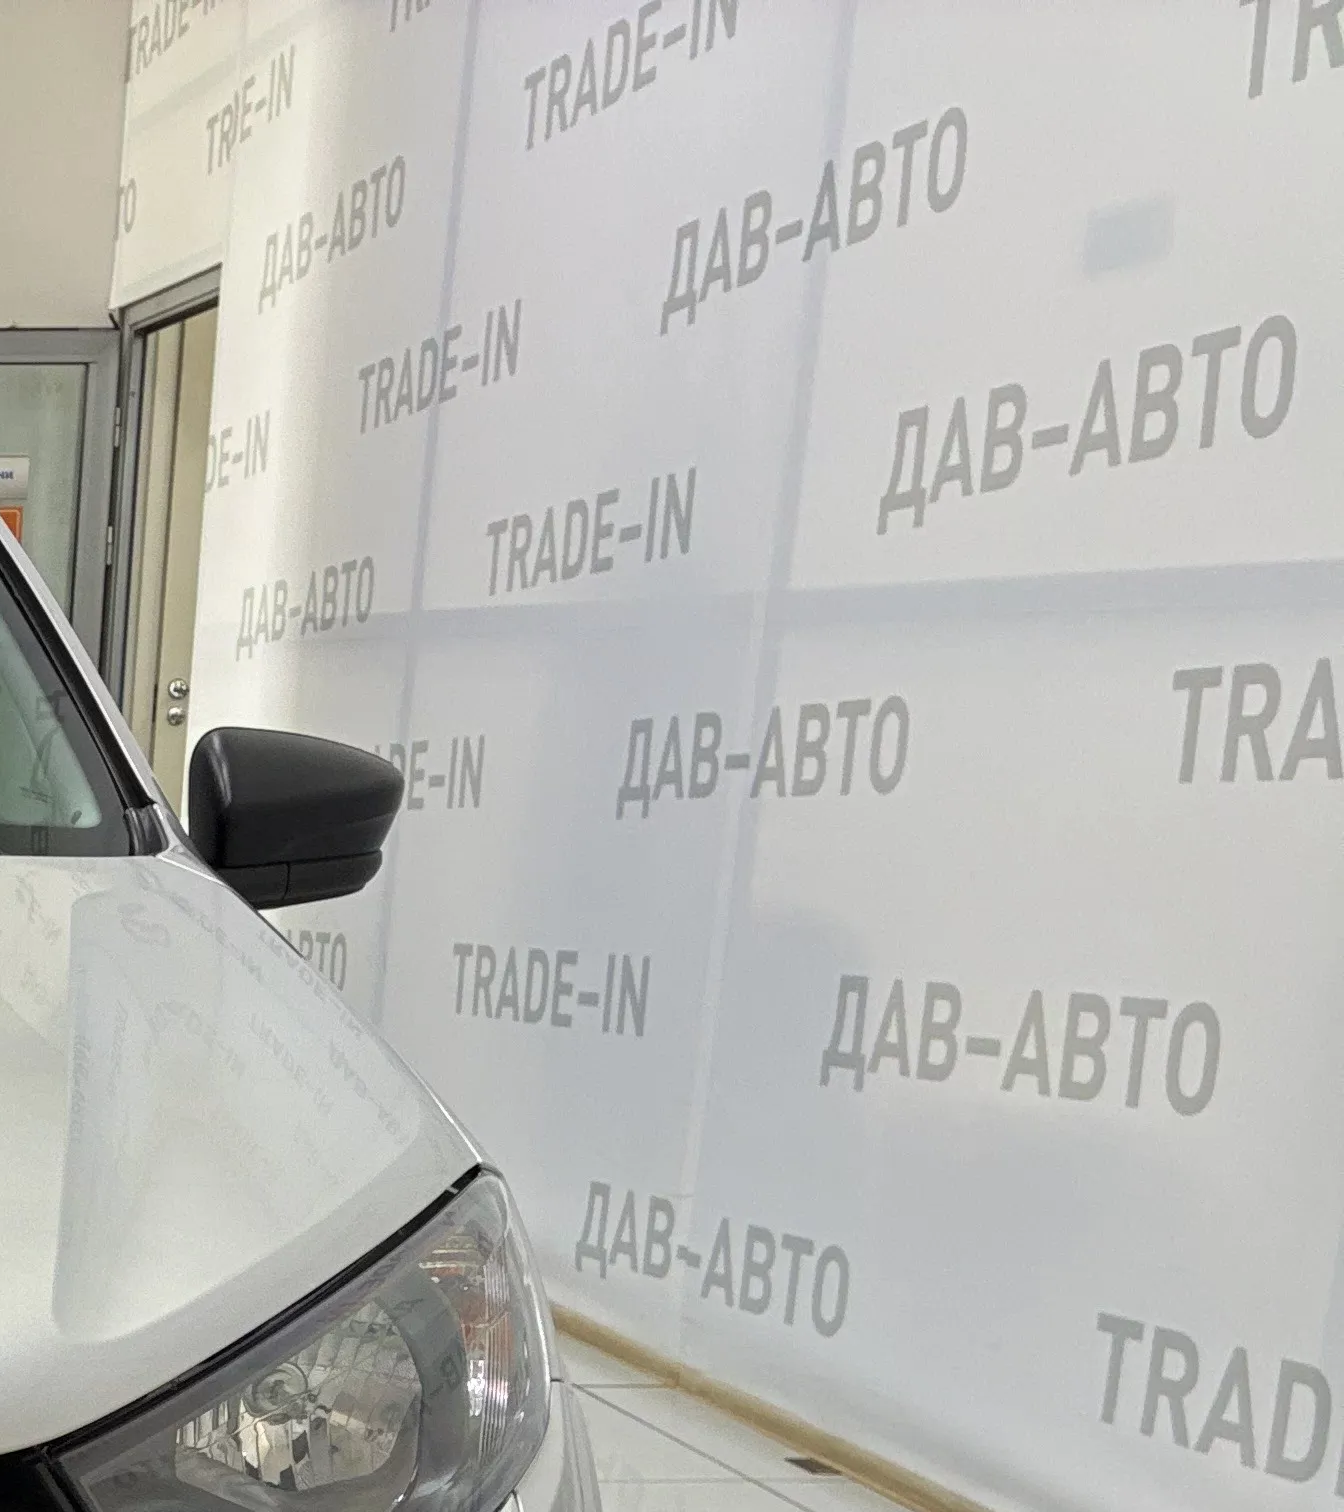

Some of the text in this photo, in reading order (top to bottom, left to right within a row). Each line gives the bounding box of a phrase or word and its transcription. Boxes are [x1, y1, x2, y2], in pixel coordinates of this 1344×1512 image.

[258, 155, 406, 315] ДАВ-АВТО
[659, 106, 969, 336] ДАВ-АВТО
[357, 299, 522, 434] TRADE-IN
[876, 314, 1299, 535] ДАВ-АВТО
[485, 467, 697, 596] TRADE-IN
[235, 556, 374, 661] ДАВ-АВТО
[615, 695, 910, 821] ДАВ-АВТО
[1172, 657, 1344, 784] TRA
[452, 943, 651, 1038] TRADE-IN
[818, 974, 1222, 1118] ДАВ-АВТО
[574, 1181, 849, 1339] ДАВ-АВТО
[1096, 1311, 1344, 1498] TRAD
